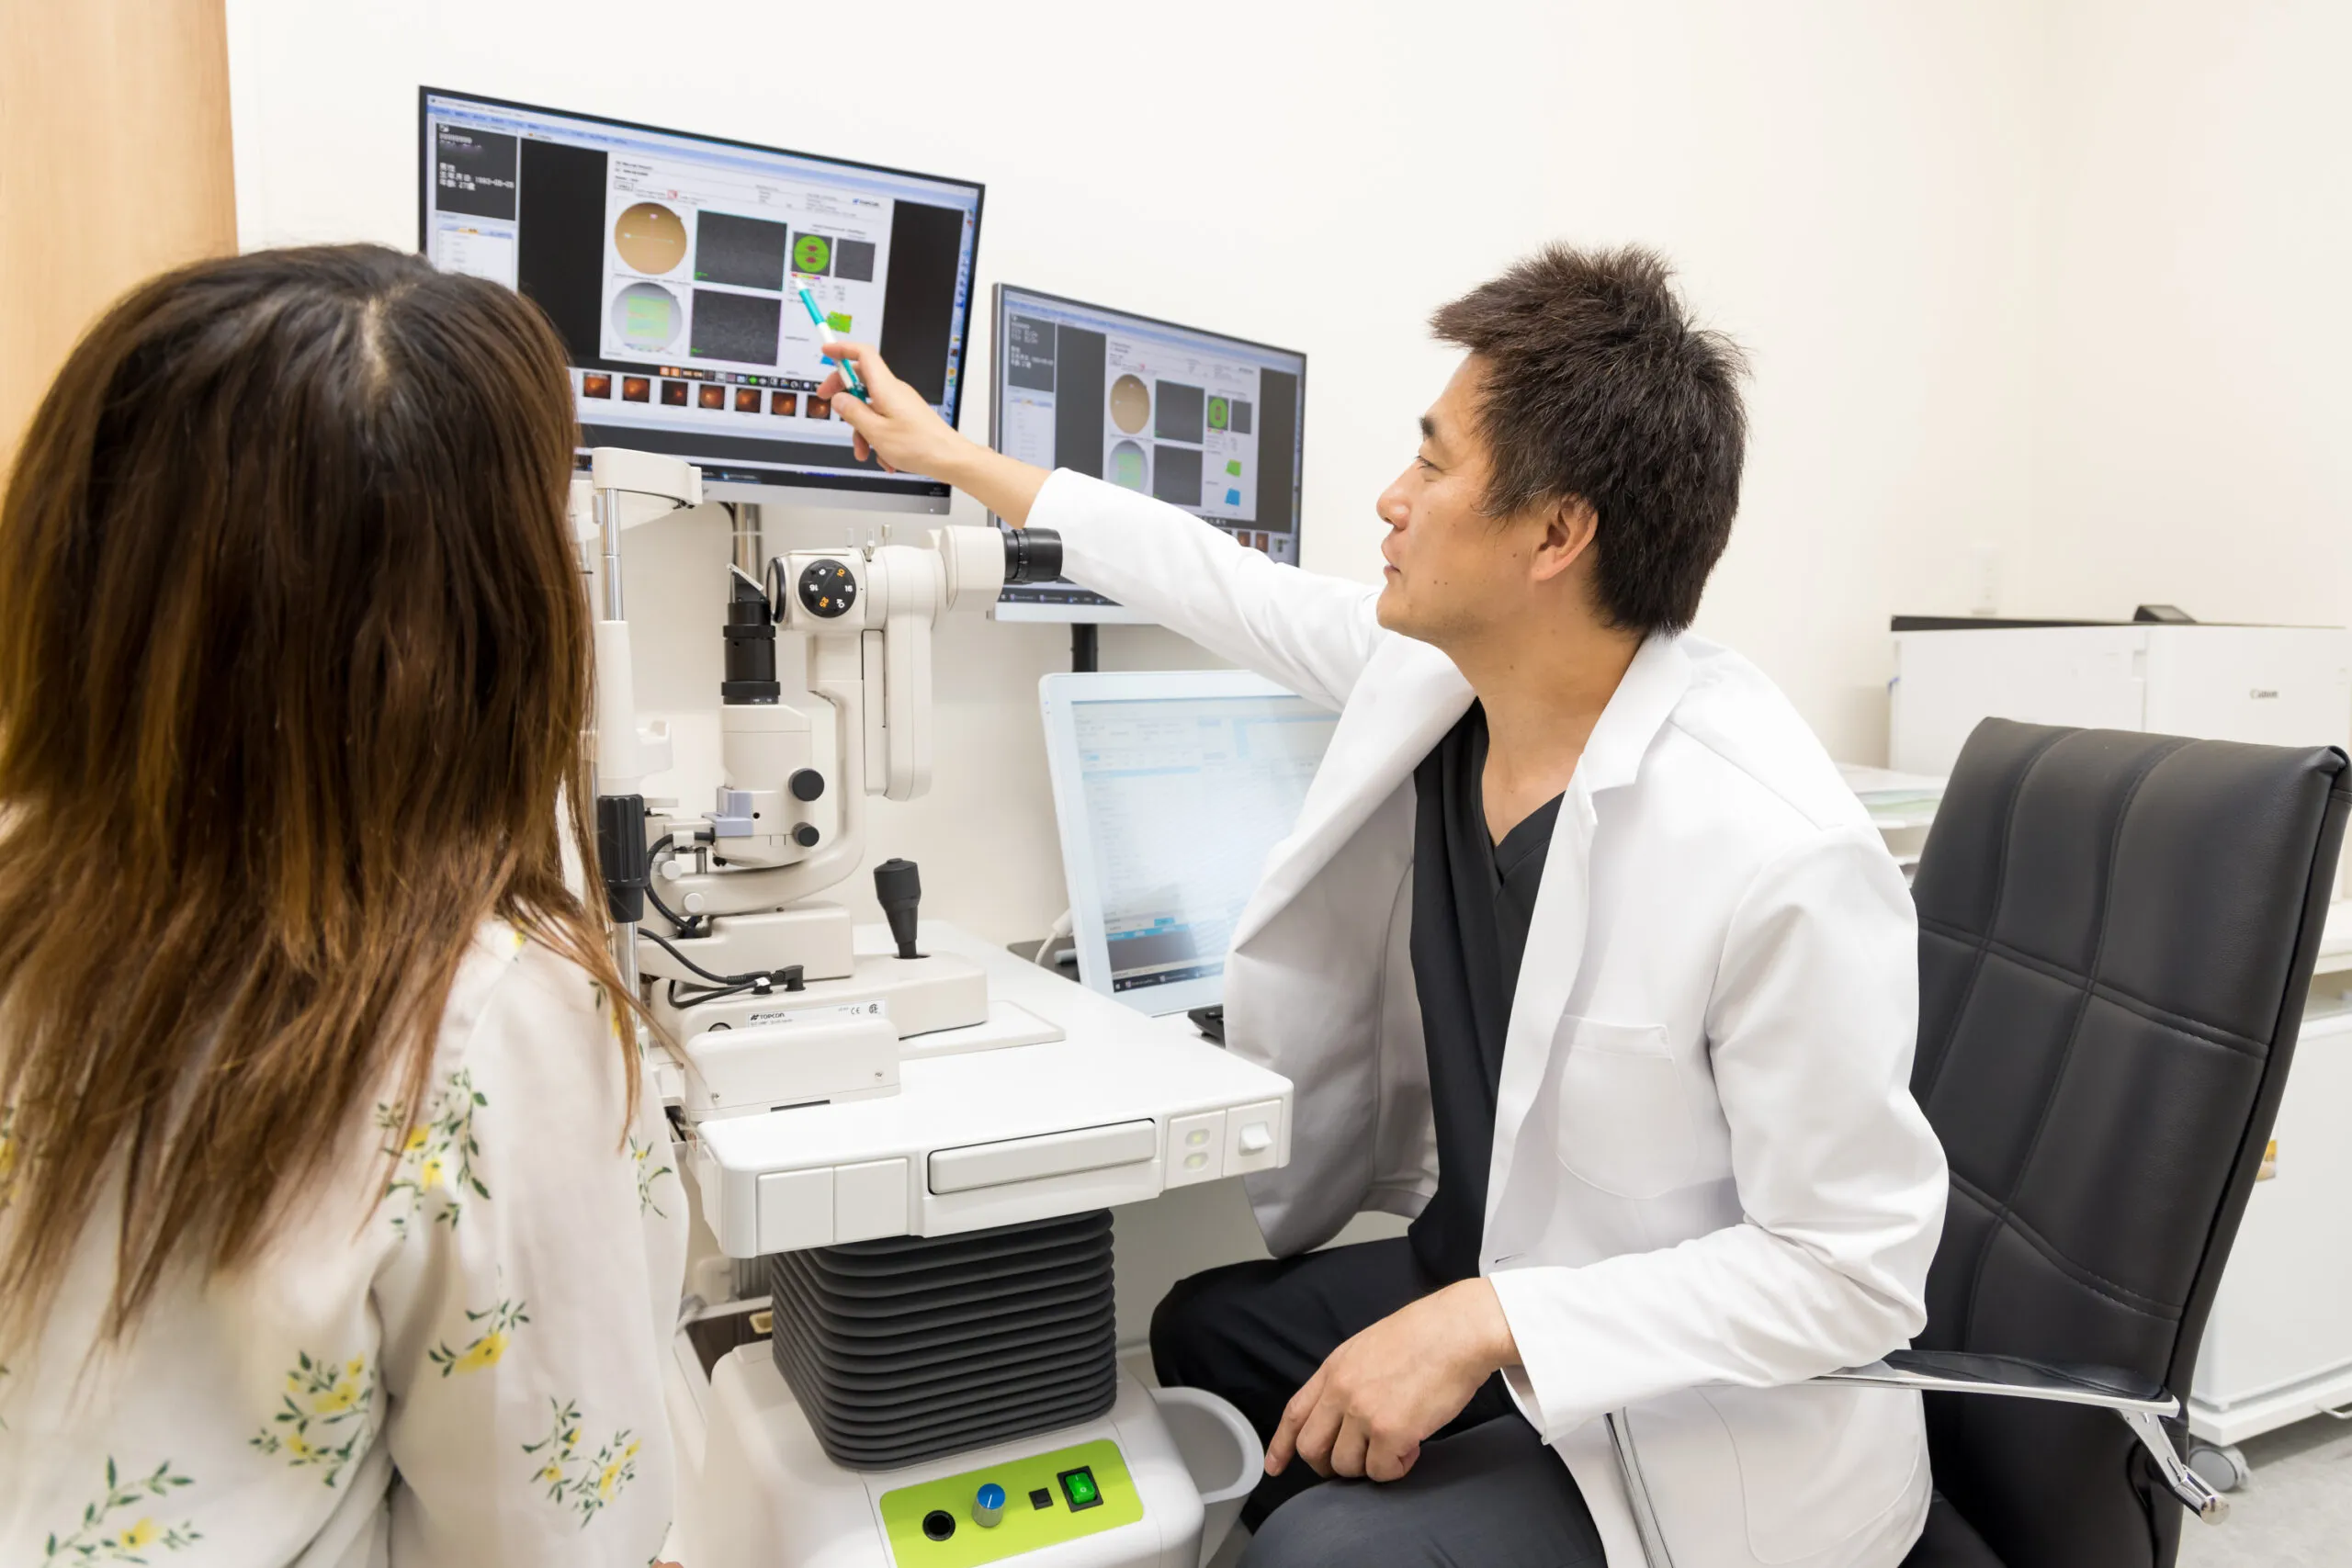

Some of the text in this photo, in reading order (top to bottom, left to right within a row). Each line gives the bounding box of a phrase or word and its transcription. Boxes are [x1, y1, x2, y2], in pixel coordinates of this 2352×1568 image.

[844, 584, 854, 592] 16
[836, 598, 845, 609] 40
[2249, 688, 2279, 699] Canon
